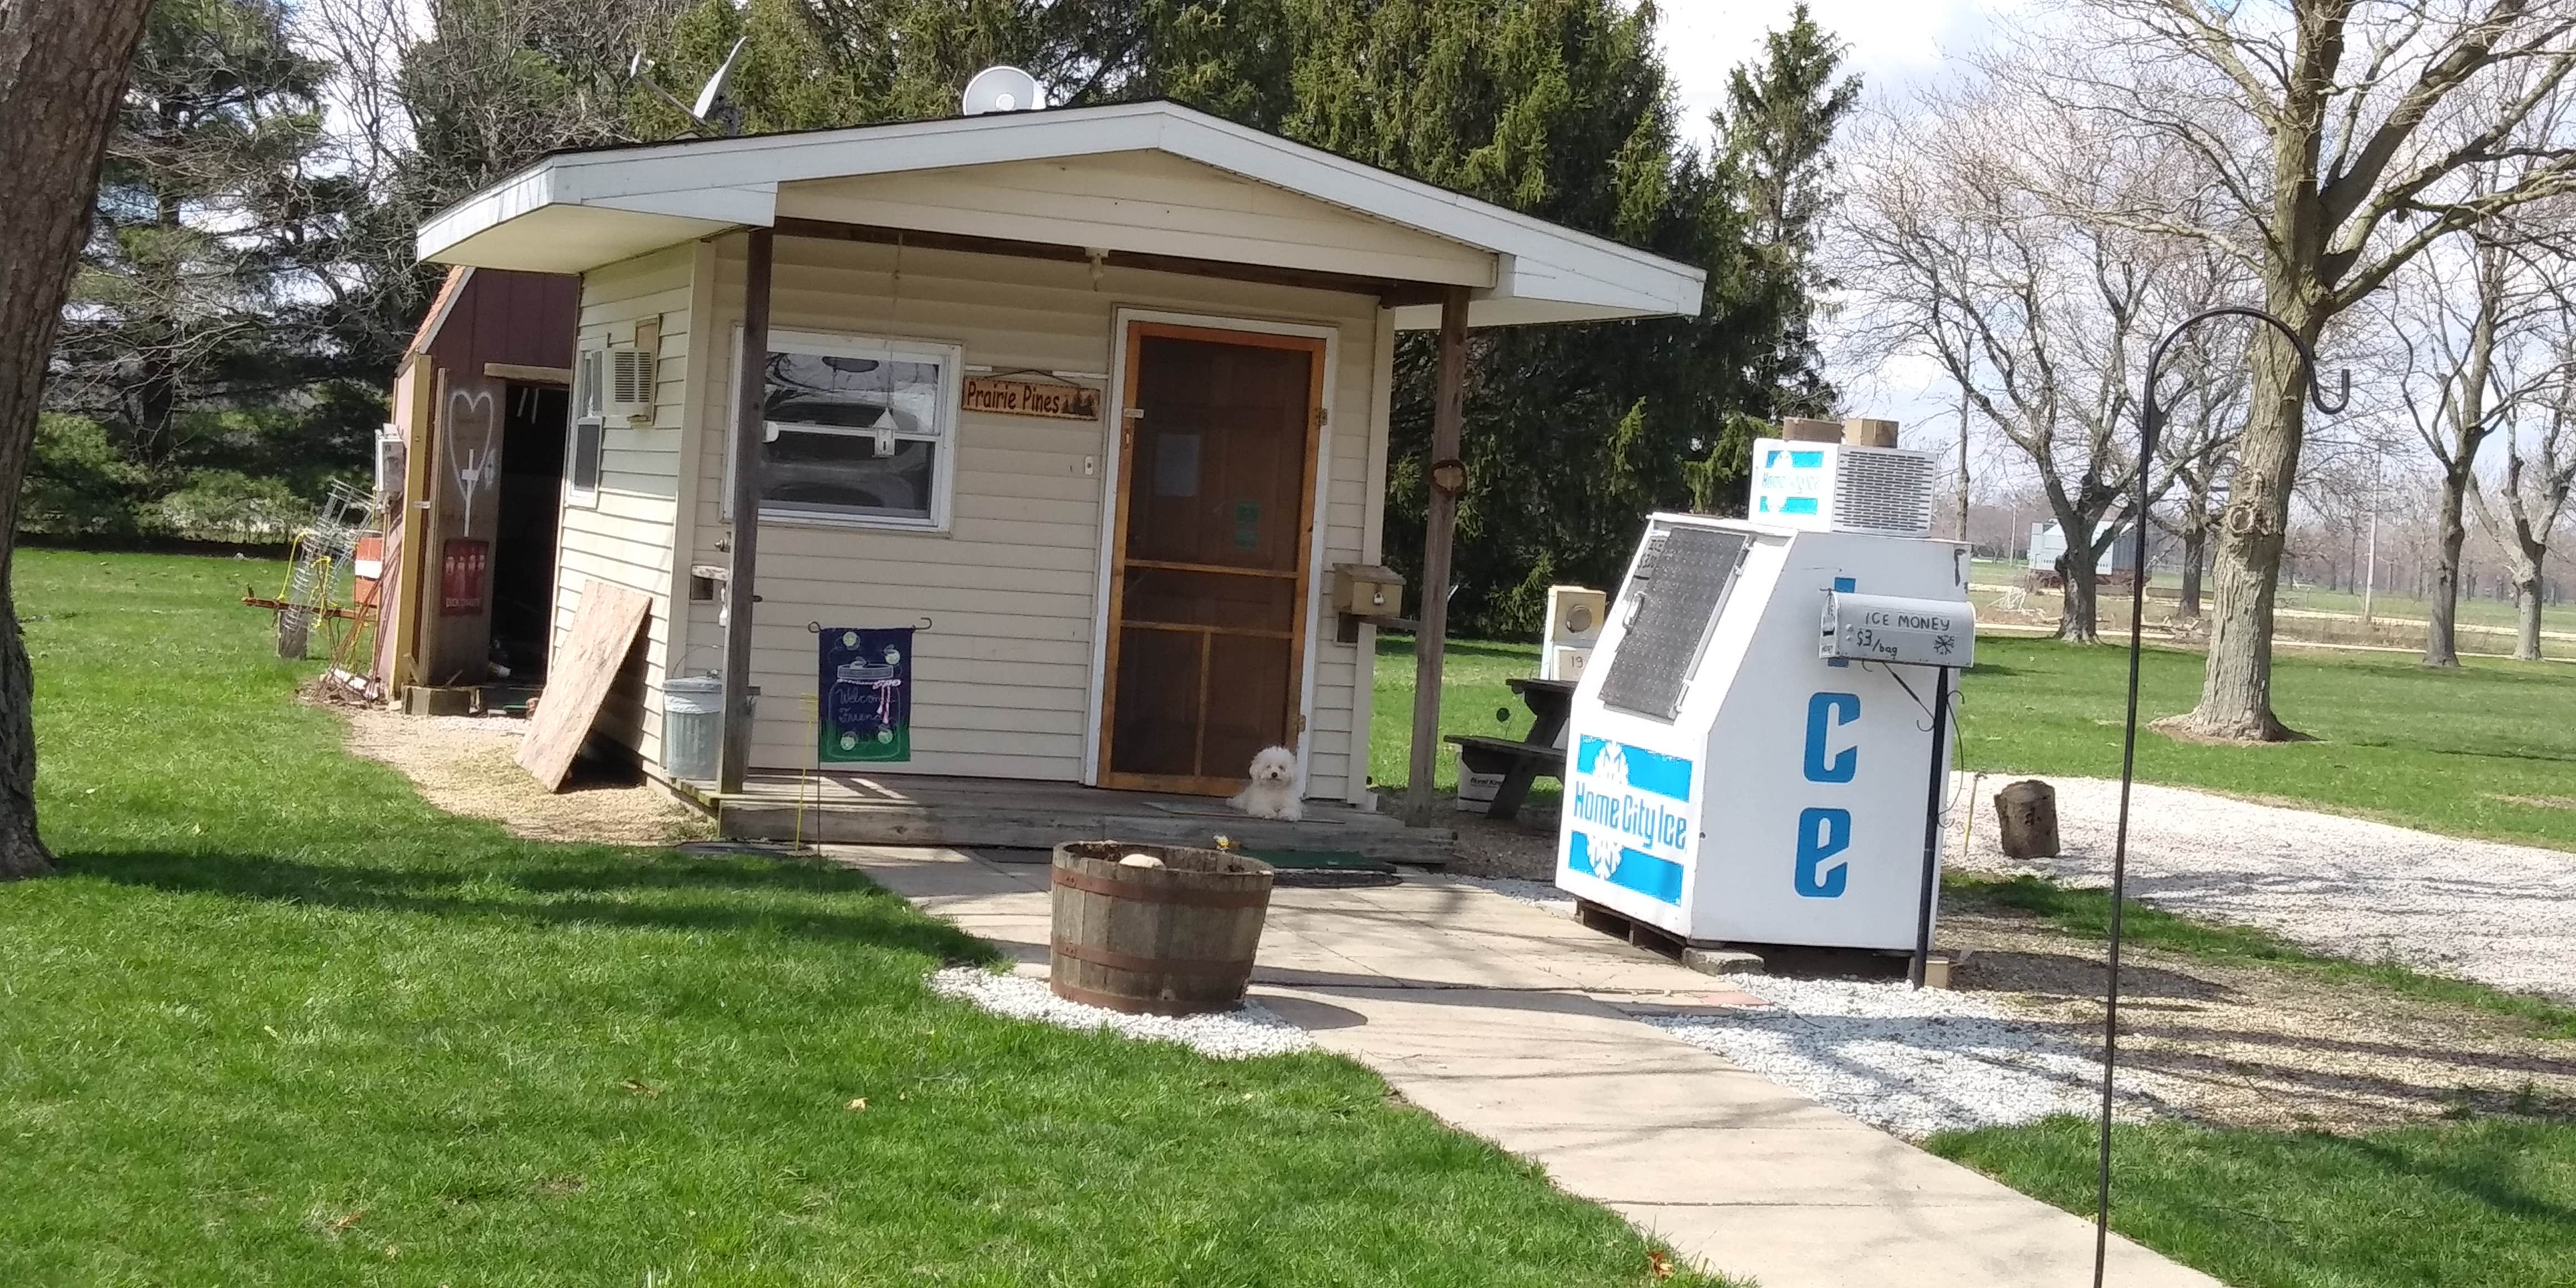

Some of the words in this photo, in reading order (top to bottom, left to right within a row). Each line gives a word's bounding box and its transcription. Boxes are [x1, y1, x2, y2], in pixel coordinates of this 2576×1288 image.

[967, 381, 1016, 410] Prairie
[1023, 385, 1059, 414] Pines
[1865, 611, 1889, 626] ICE
[1898, 614, 1950, 632] MONEY
[1571, 656, 1583, 668] 19
[835, 687, 896, 705] Welcom
[1794, 577, 1860, 898] ce
[1573, 781, 1620, 829] Home
[1622, 794, 1656, 850] City
[1657, 804, 1687, 850] Ice
